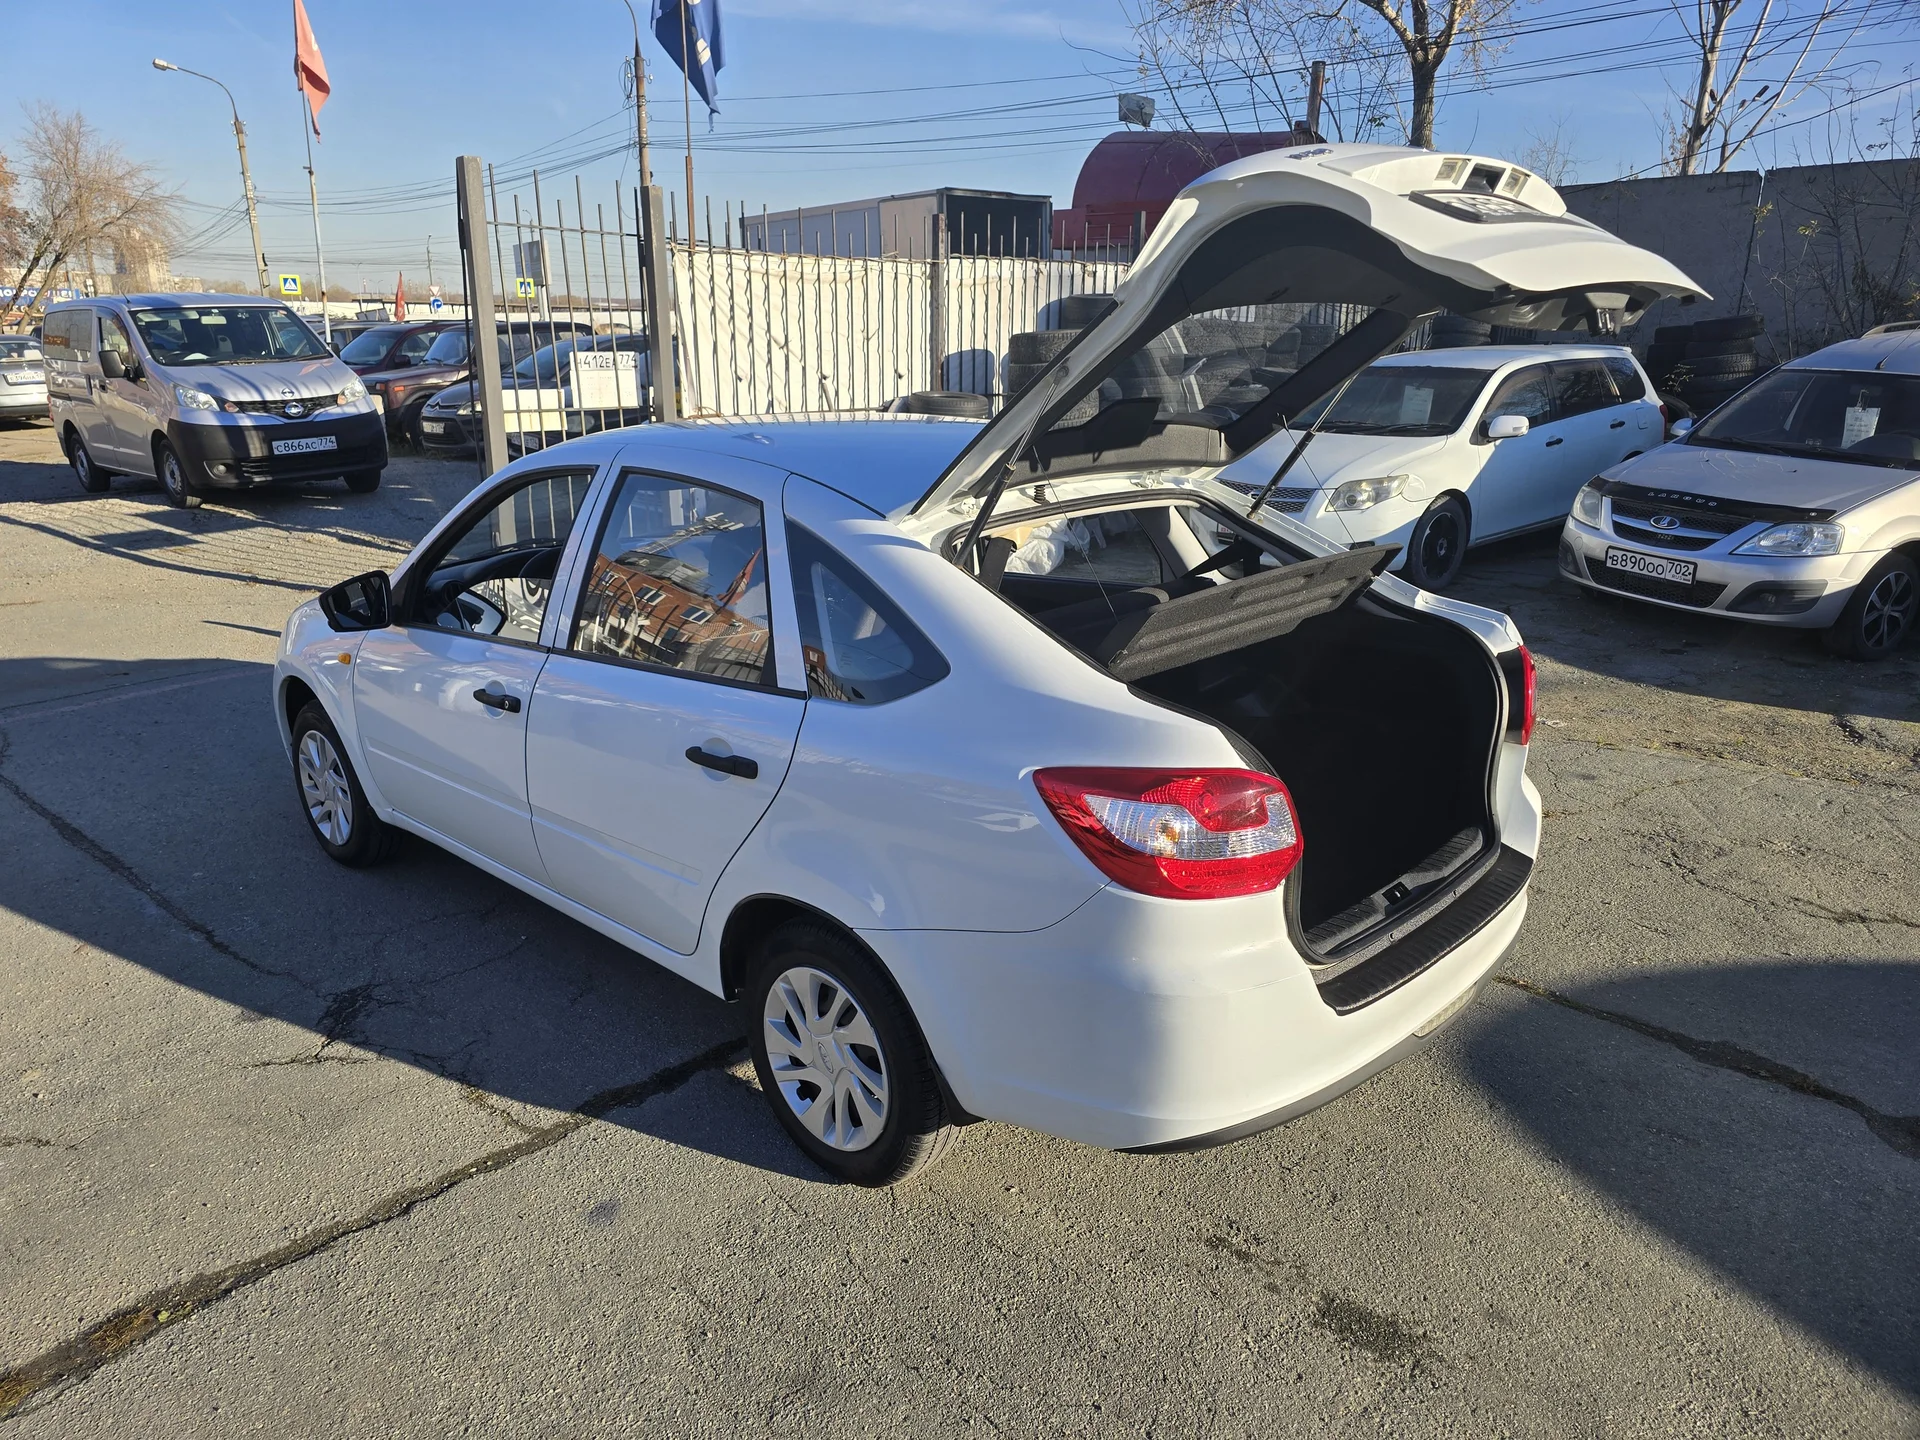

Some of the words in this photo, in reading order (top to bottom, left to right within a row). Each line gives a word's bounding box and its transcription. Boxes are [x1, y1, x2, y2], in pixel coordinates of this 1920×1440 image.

[276, 441, 317, 453] С866АС
[318, 437, 334, 446] 774
[1611, 554, 1664, 575] В890ОО
[1668, 561, 1690, 577] 702
